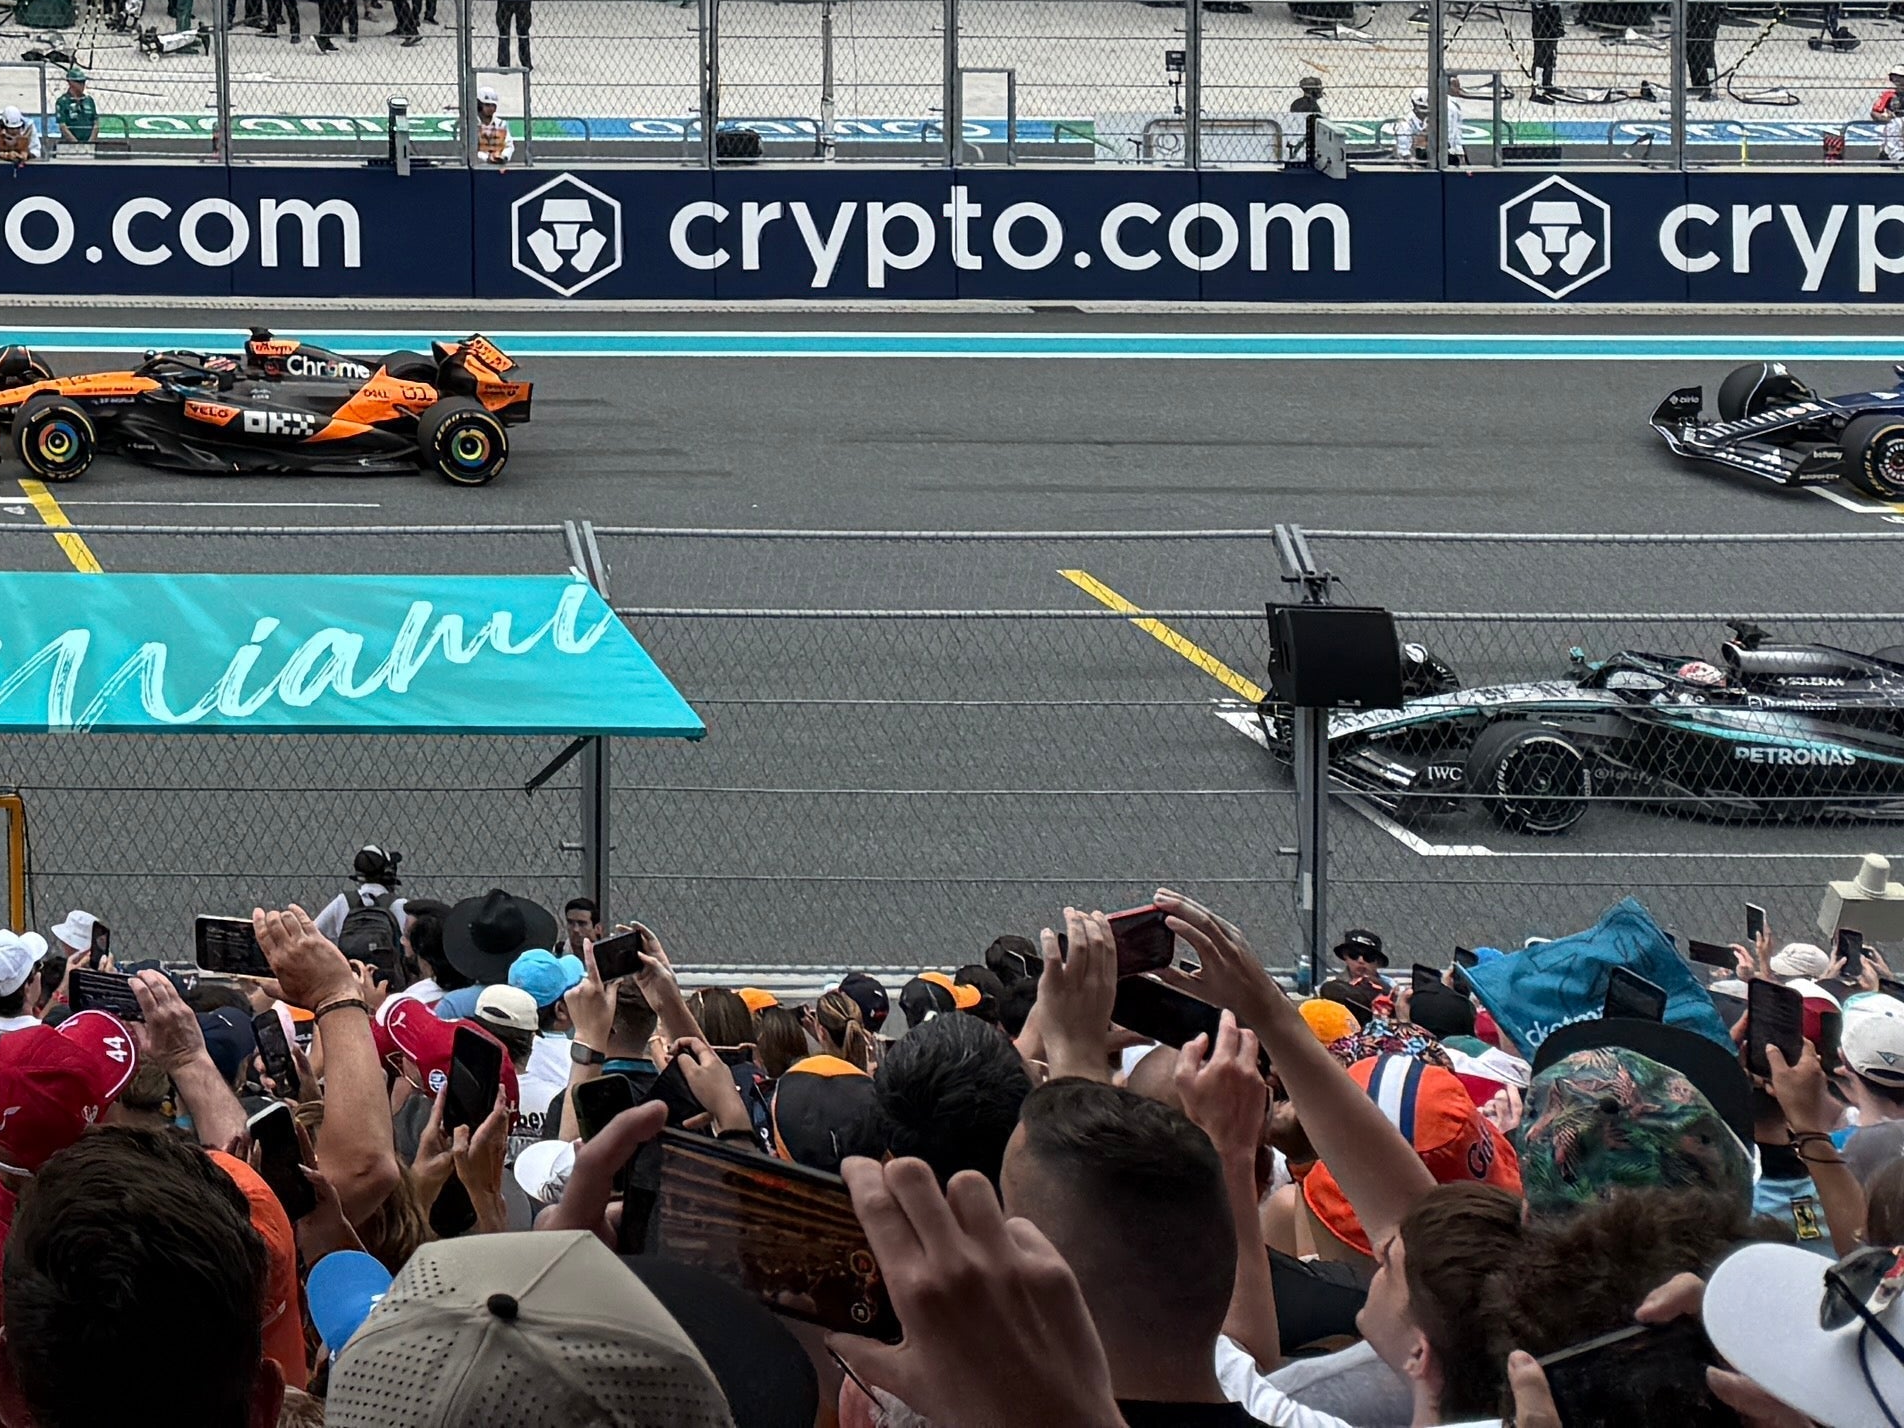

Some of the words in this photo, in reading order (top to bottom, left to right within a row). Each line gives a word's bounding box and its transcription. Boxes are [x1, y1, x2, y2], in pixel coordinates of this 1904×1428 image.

[669, 185, 1351, 289] crypto.com
[286, 355, 370, 380] Chrome
[191, 404, 229, 418] VELO
[244, 409, 316, 436] OKX
[1734, 745, 1856, 766] PETRONAS
[1428, 766, 1463, 781] IWC
[102, 1035, 127, 1064] 44
